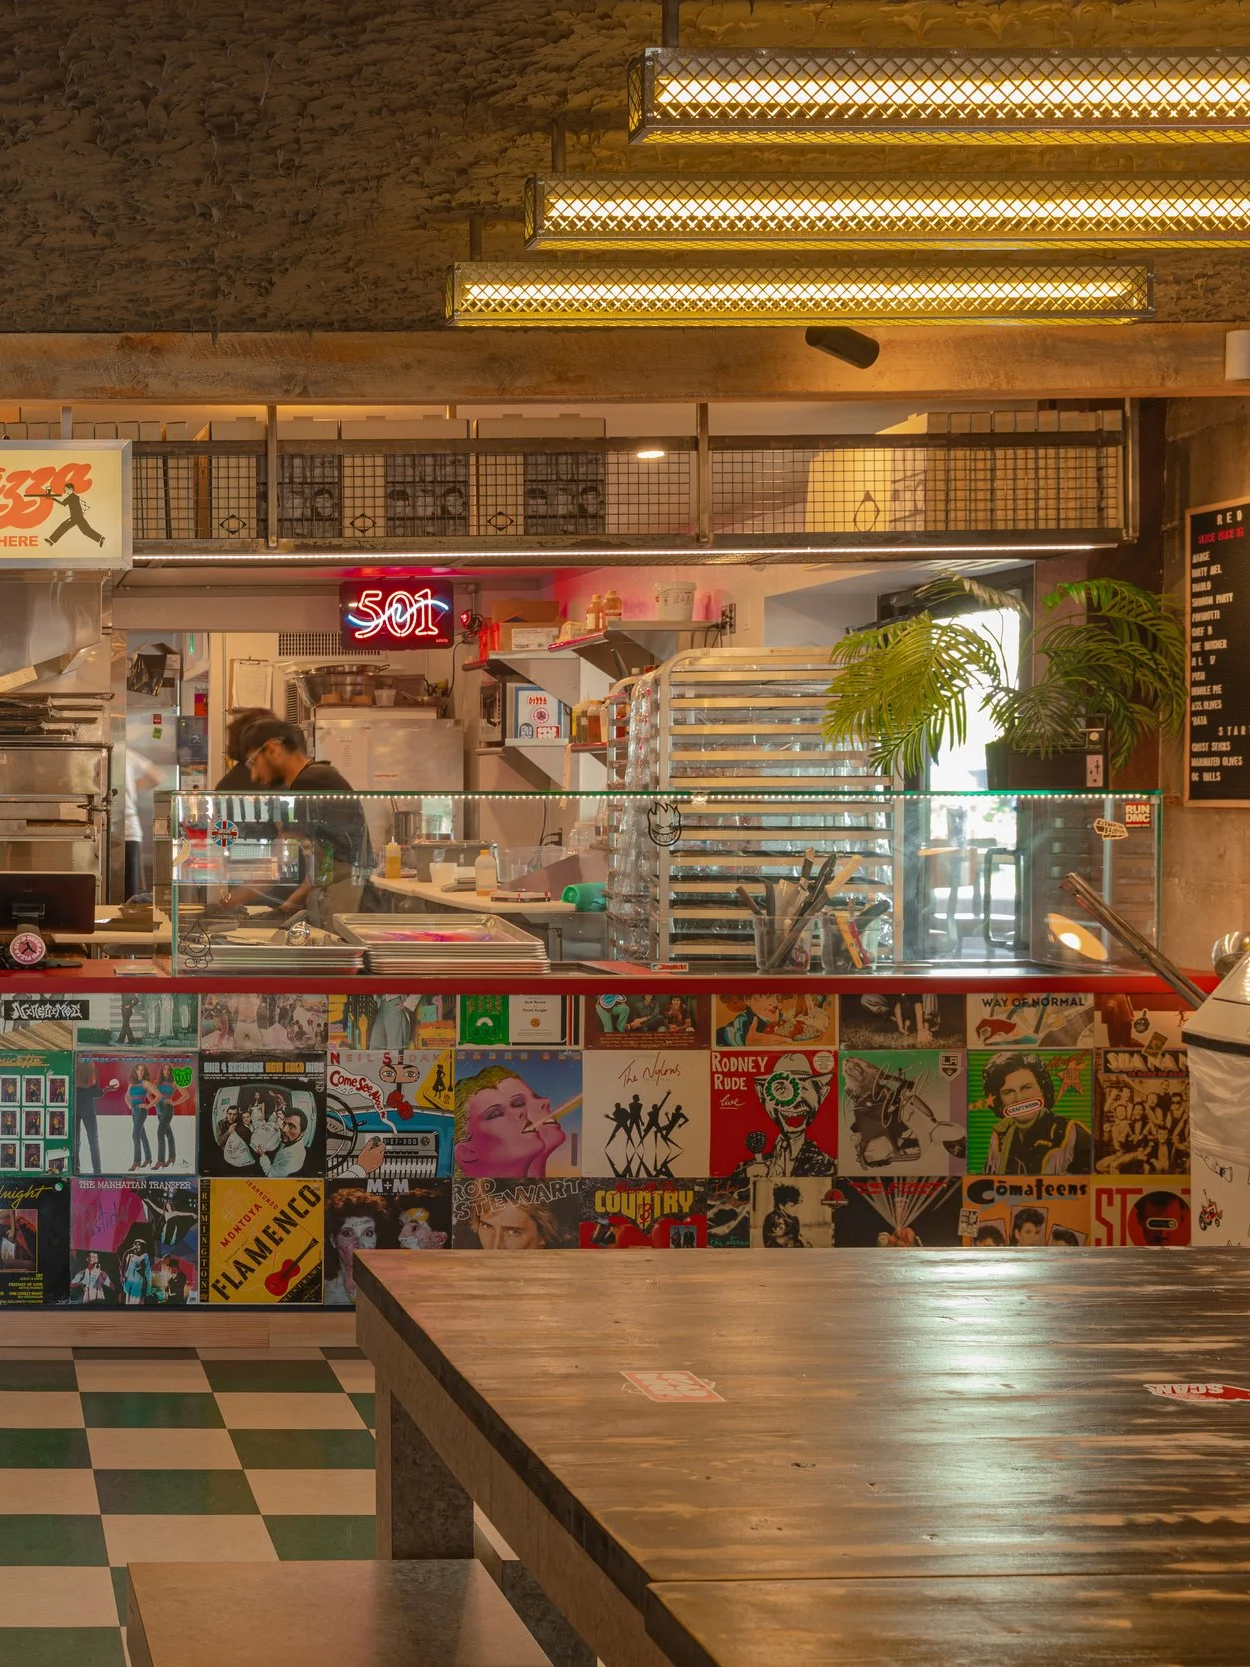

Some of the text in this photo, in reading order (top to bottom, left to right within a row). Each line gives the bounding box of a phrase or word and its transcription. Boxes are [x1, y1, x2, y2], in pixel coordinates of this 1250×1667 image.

[354, 588, 439, 639] 501
[1217, 725, 1250, 737] STAR
[1125, 804, 1150, 814] RUN
[1125, 813, 1151, 823] DMC
[982, 996, 1085, 1008] WAY OF NORMAL
[618, 1051, 681, 1088] The Nylons
[711, 1052, 768, 1073] RODNEY
[714, 1075, 748, 1091] RUDE
[79, 1180, 192, 1190] THE MANHATTAN TRANSFER
[452, 1178, 497, 1203] ROD
[454, 1178, 582, 1221] STEWART
[594, 1190, 695, 1231] COUNTRY
[219, 1203, 263, 1248] MONTOYA
[200, 1191, 209, 1289] REMINGTON
[210, 1184, 322, 1301] FLAMENCO
